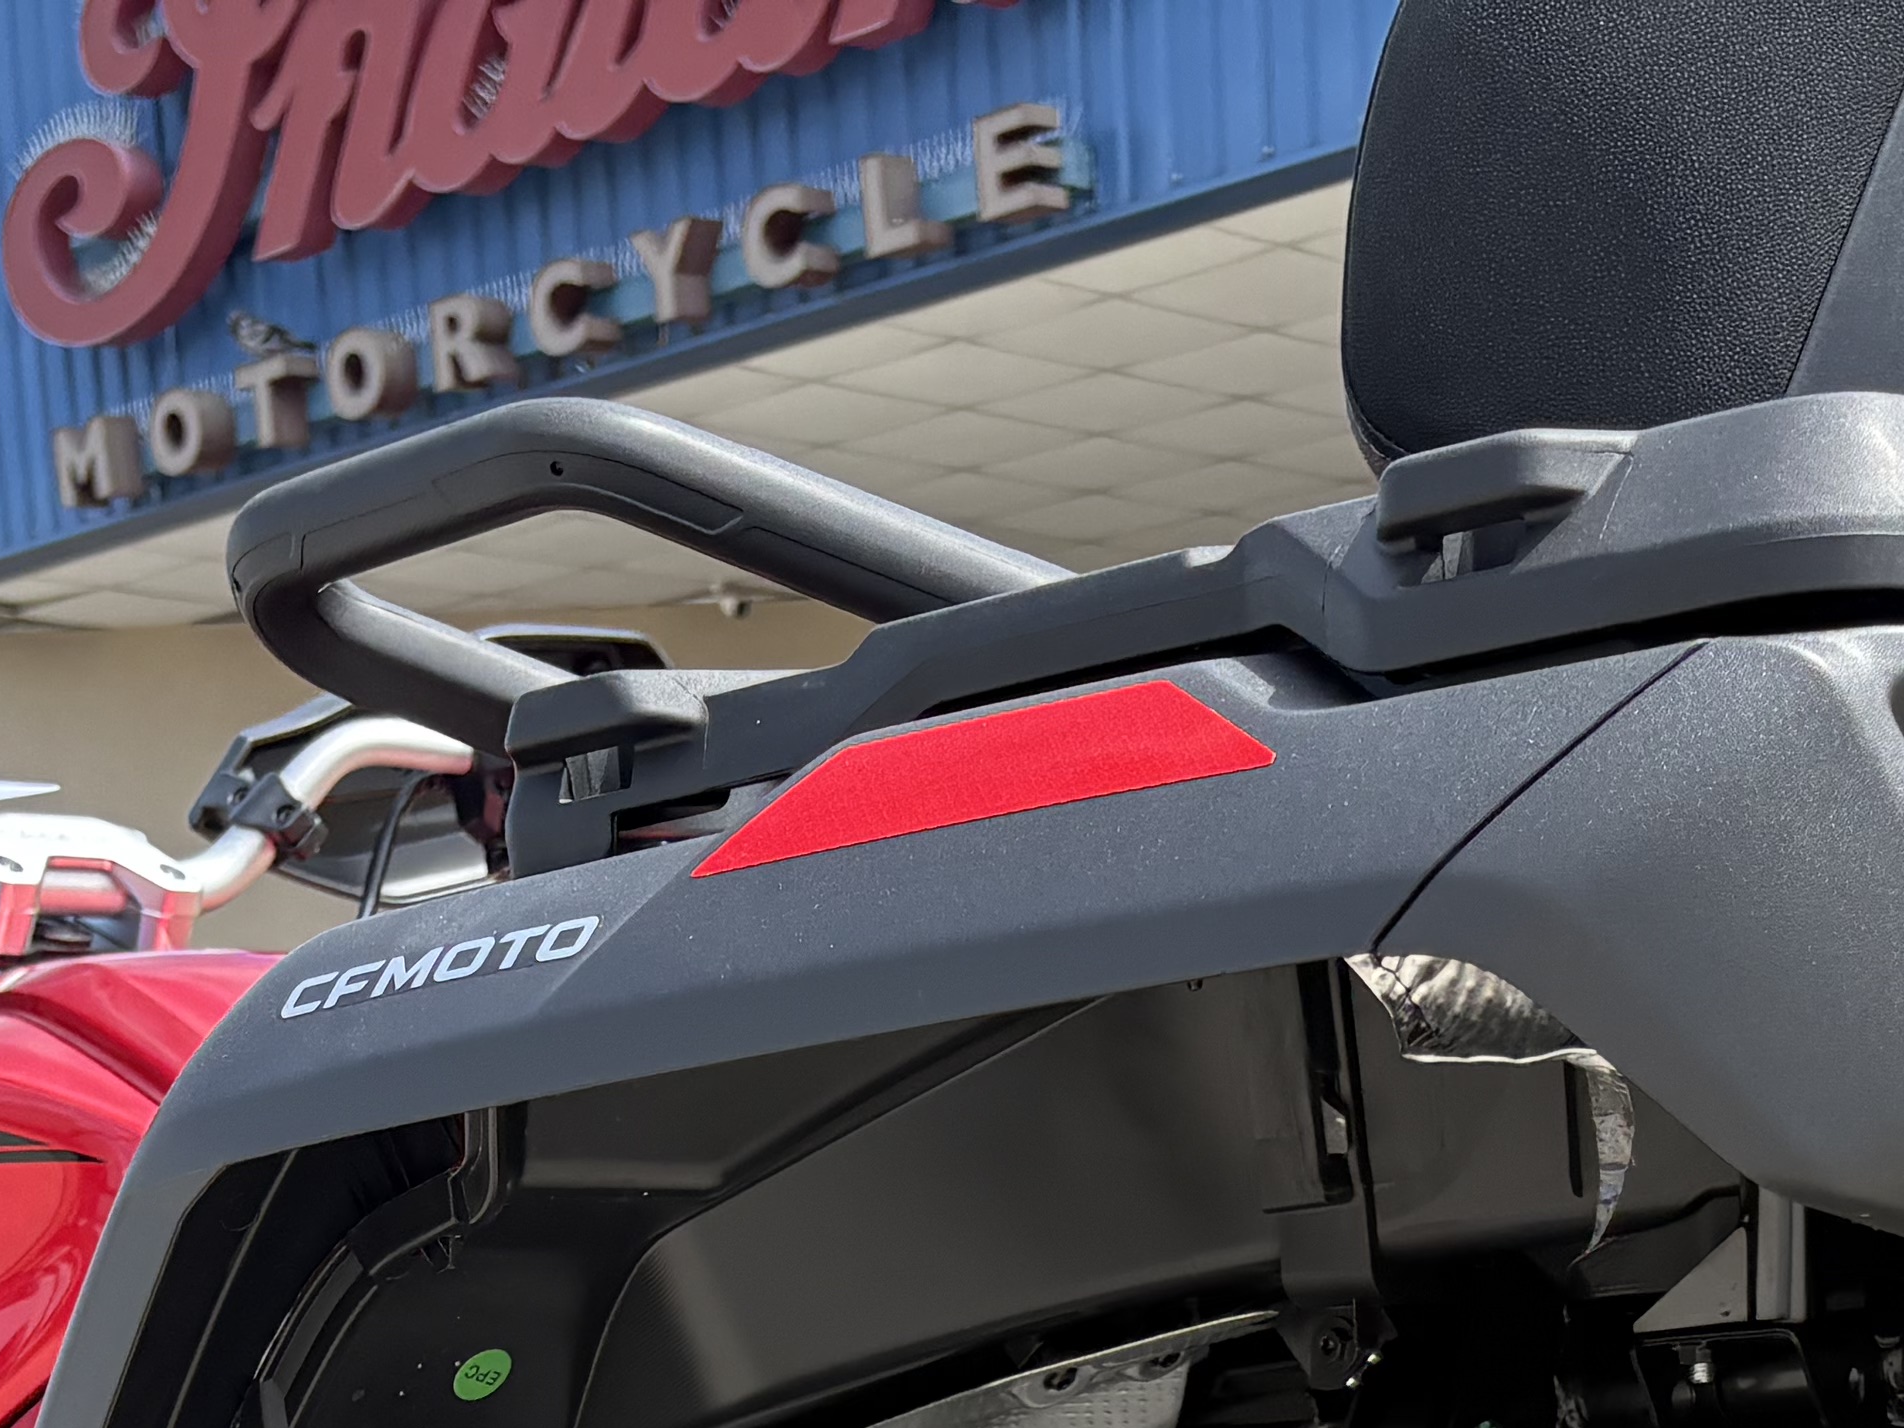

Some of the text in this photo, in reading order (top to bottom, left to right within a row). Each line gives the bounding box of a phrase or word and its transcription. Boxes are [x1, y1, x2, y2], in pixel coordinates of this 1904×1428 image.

[53, 101, 1070, 509] MOTORCYCLE
[281, 916, 599, 1019] CFMOTO
[464, 1365, 501, 1385] EPC
